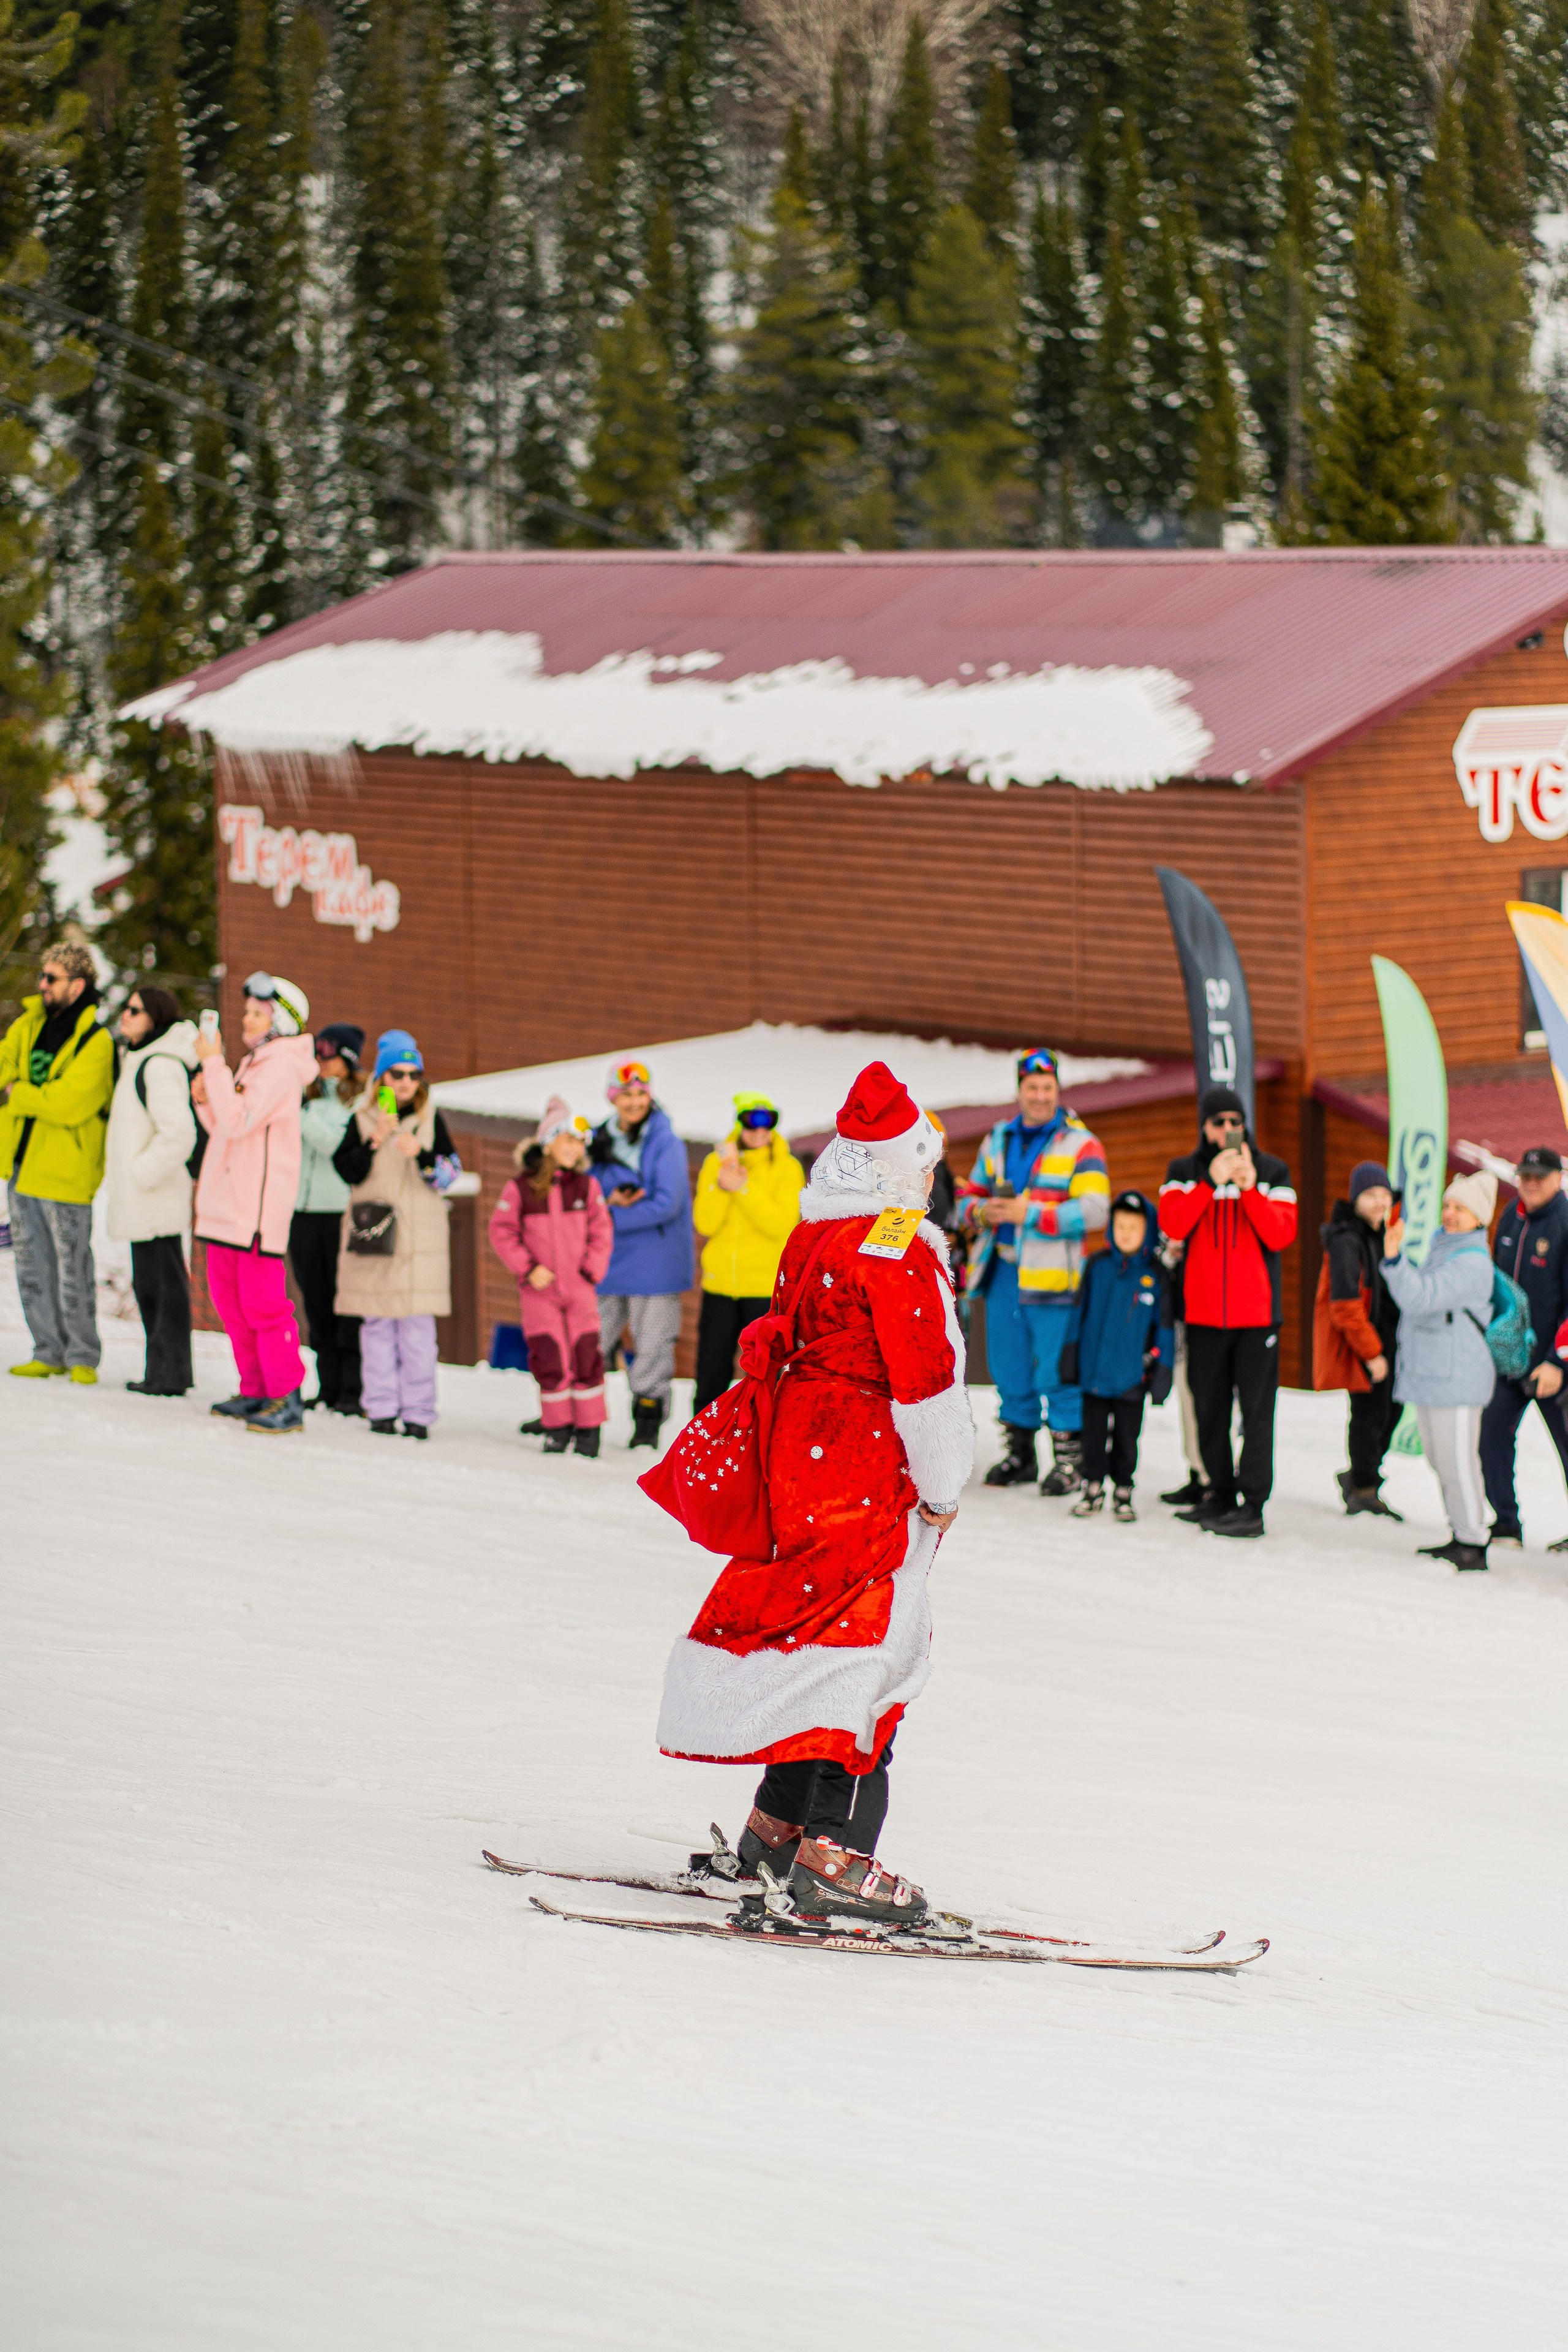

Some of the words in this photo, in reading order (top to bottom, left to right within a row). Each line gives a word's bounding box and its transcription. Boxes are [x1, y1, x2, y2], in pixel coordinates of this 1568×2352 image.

[219, 805, 358, 908] Терем
[881, 1226, 906, 1234] билайн
[821, 1937, 892, 1951] ATOMIC
